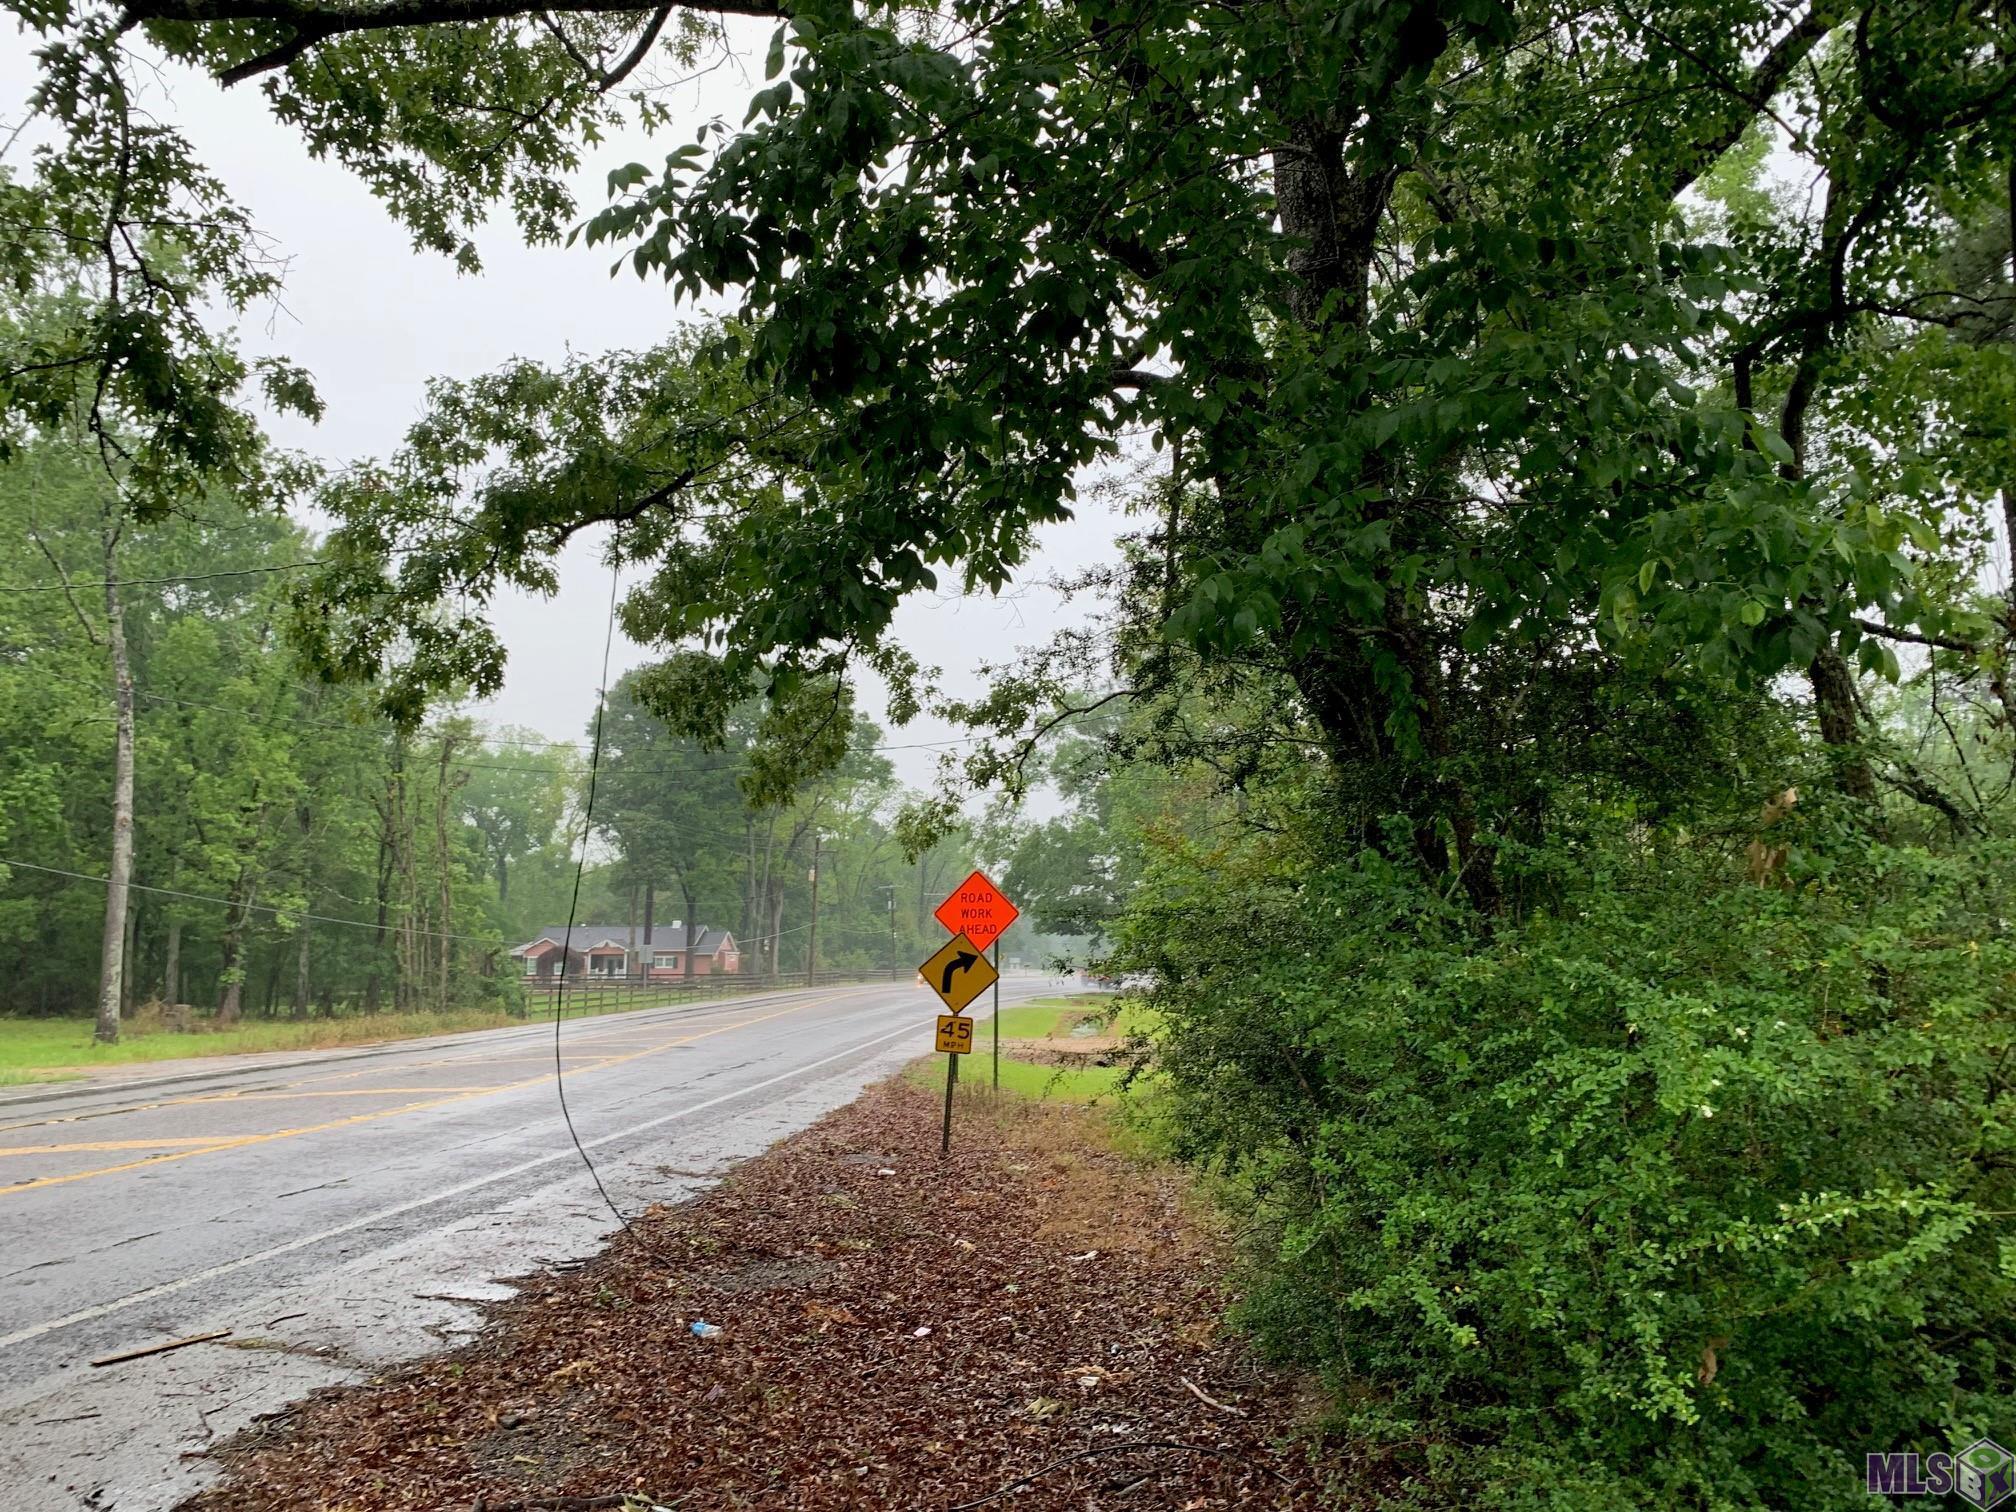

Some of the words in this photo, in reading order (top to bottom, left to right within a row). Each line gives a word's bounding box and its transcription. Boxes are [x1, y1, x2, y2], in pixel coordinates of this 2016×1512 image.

[960, 893, 993, 903] ROAD
[961, 908, 993, 919] WORK
[959, 924, 997, 935] AHEAD
[940, 1021, 970, 1039] 45
[943, 1041, 964, 1049] MPH
